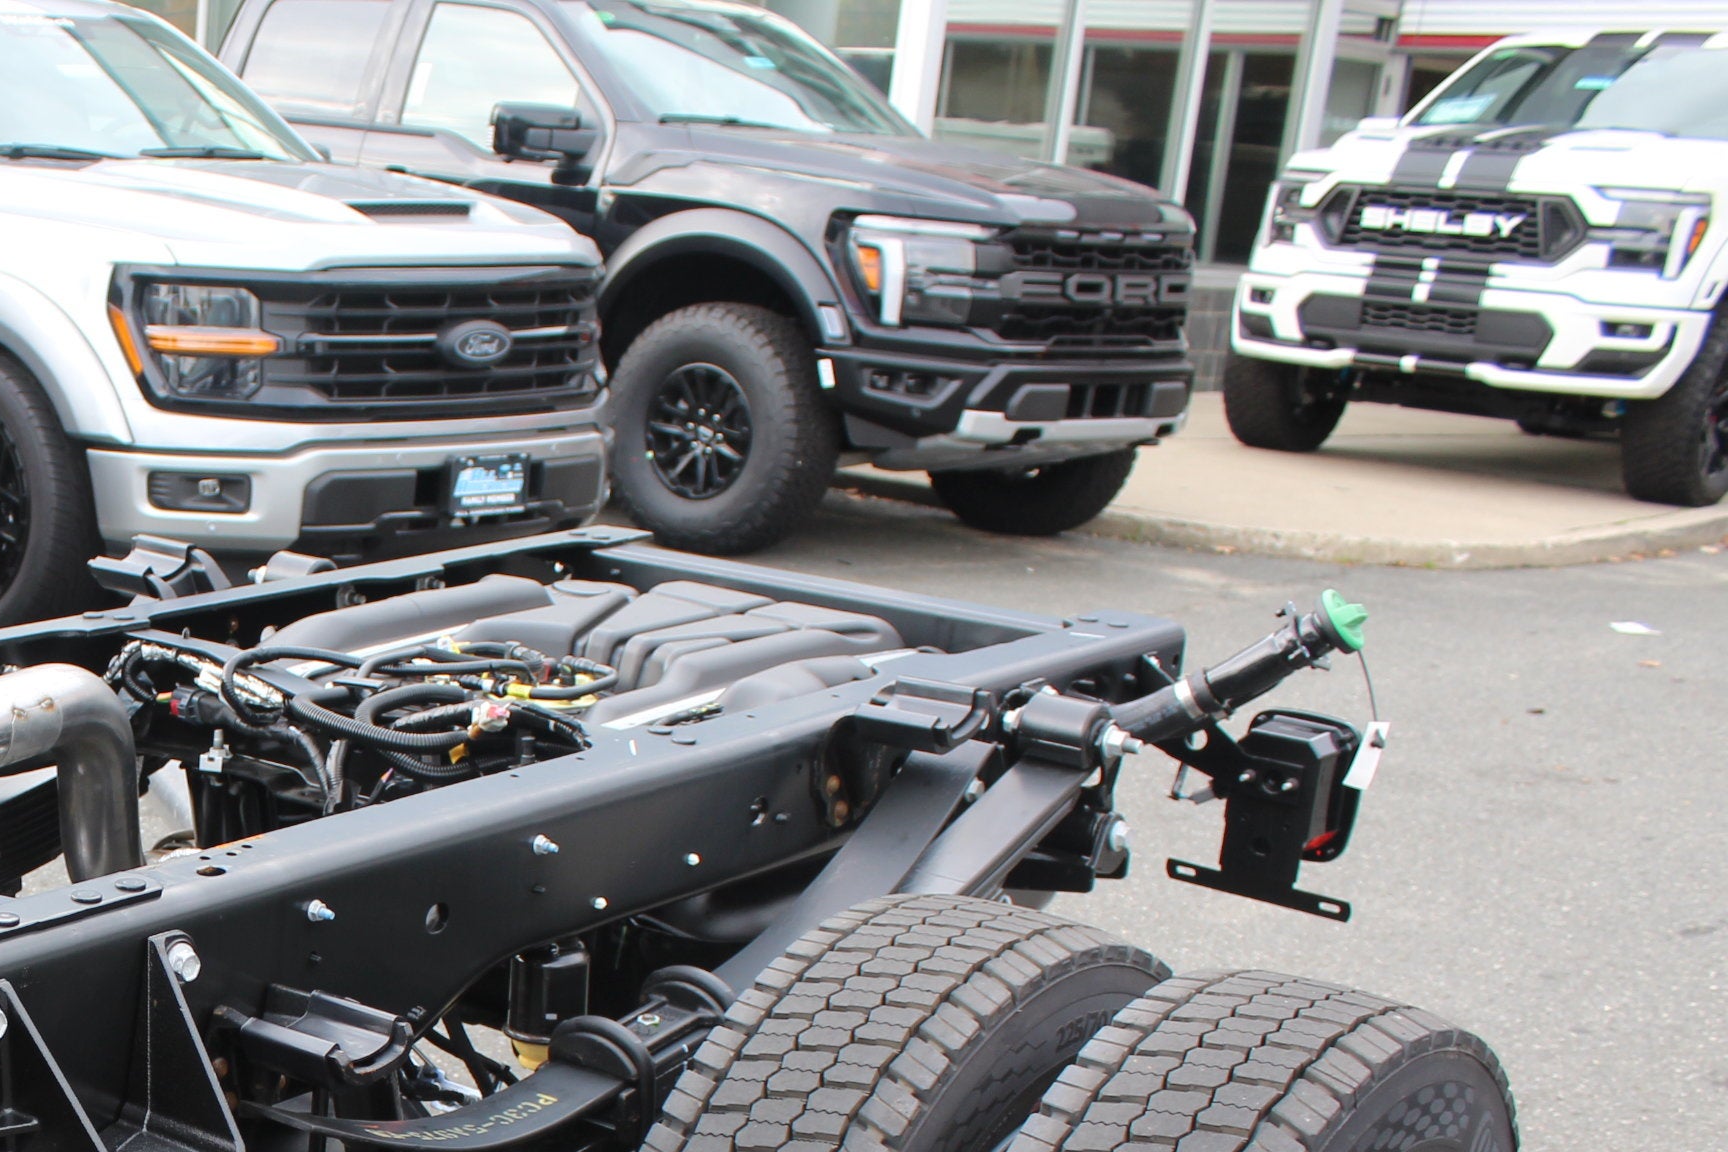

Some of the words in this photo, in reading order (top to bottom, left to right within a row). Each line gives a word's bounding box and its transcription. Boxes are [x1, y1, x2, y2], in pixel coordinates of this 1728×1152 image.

[1360, 205, 1528, 237] SHELBY
[1010, 271, 1192, 306] FORD
[465, 334, 500, 354] Ford
